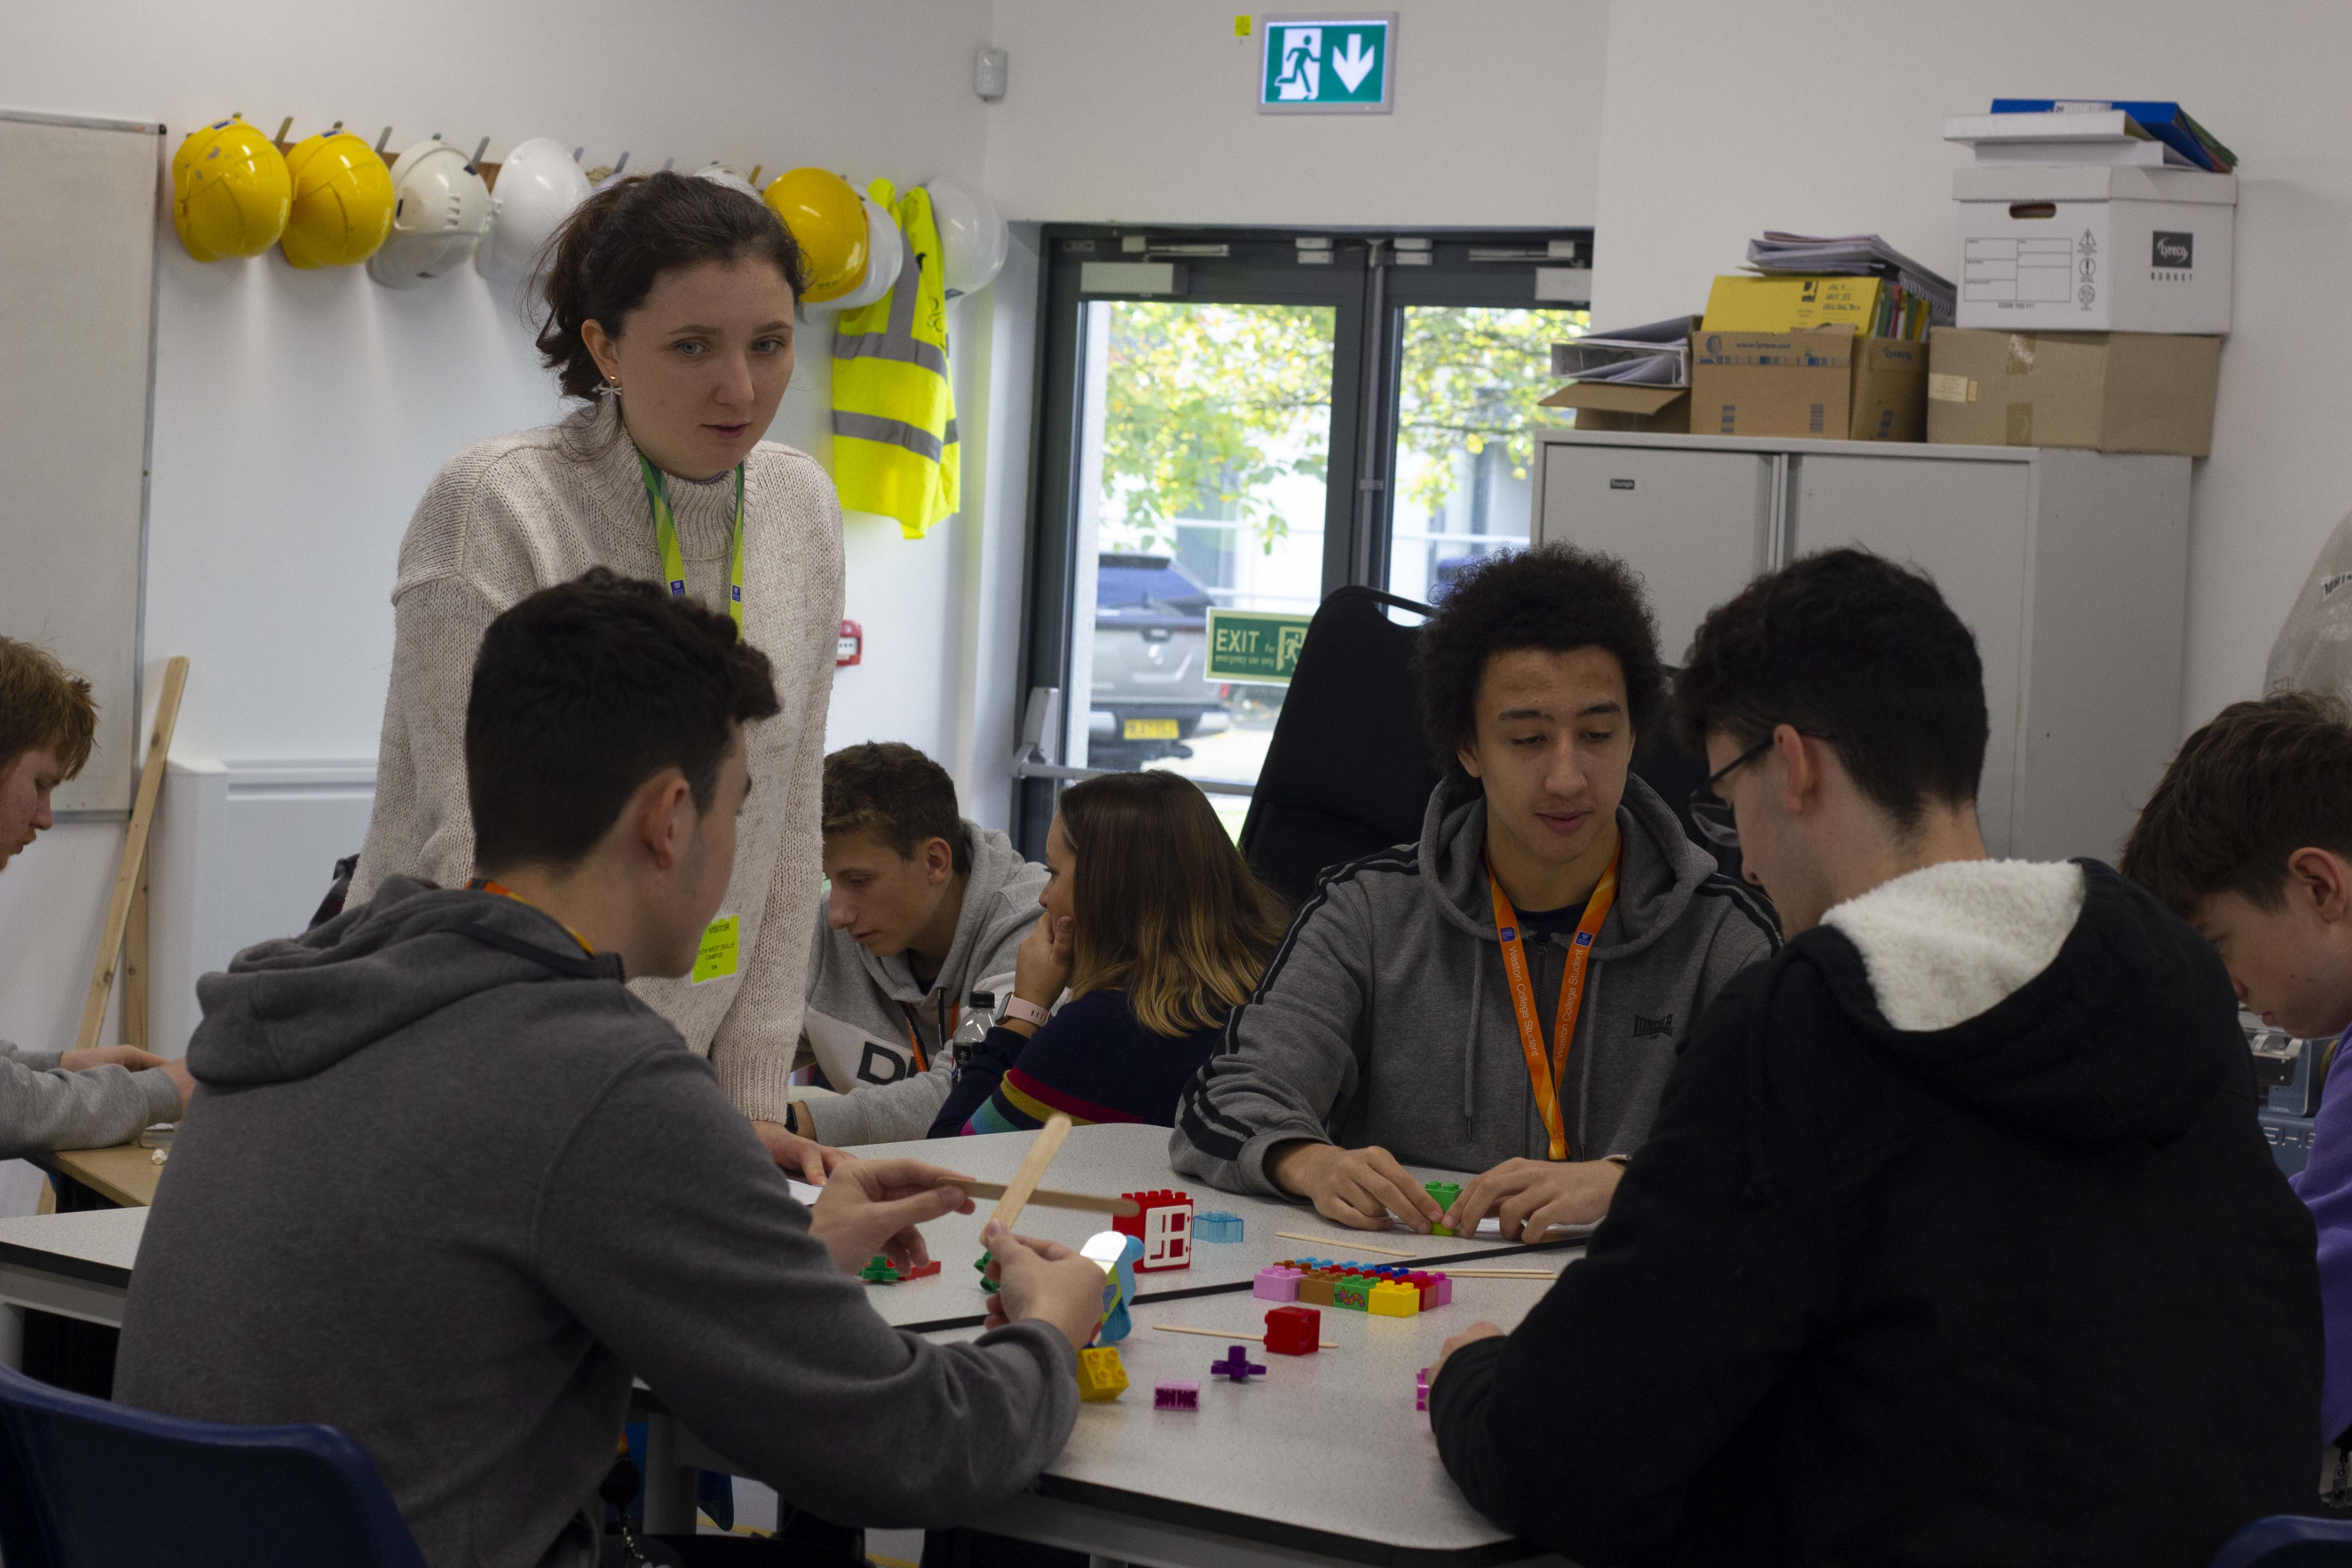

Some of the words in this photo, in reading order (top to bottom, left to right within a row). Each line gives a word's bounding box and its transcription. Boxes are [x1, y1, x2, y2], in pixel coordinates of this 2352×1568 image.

[2151, 272, 2193, 282] BUDGET
[1216, 628, 1260, 653] EXIT
[1215, 654, 1247, 666] emergency
[1261, 658, 1275, 668] only
[708, 924, 730, 934] VISITOR
[706, 952, 723, 961] CAMPUS
[1568, 949, 1584, 986] Student
[1509, 945, 1522, 982] Weston
[1516, 983, 1529, 1019] College
[1524, 1020, 1540, 1057] Student
[1562, 987, 1576, 1021] College
[1557, 1023, 1569, 1059] Weston
